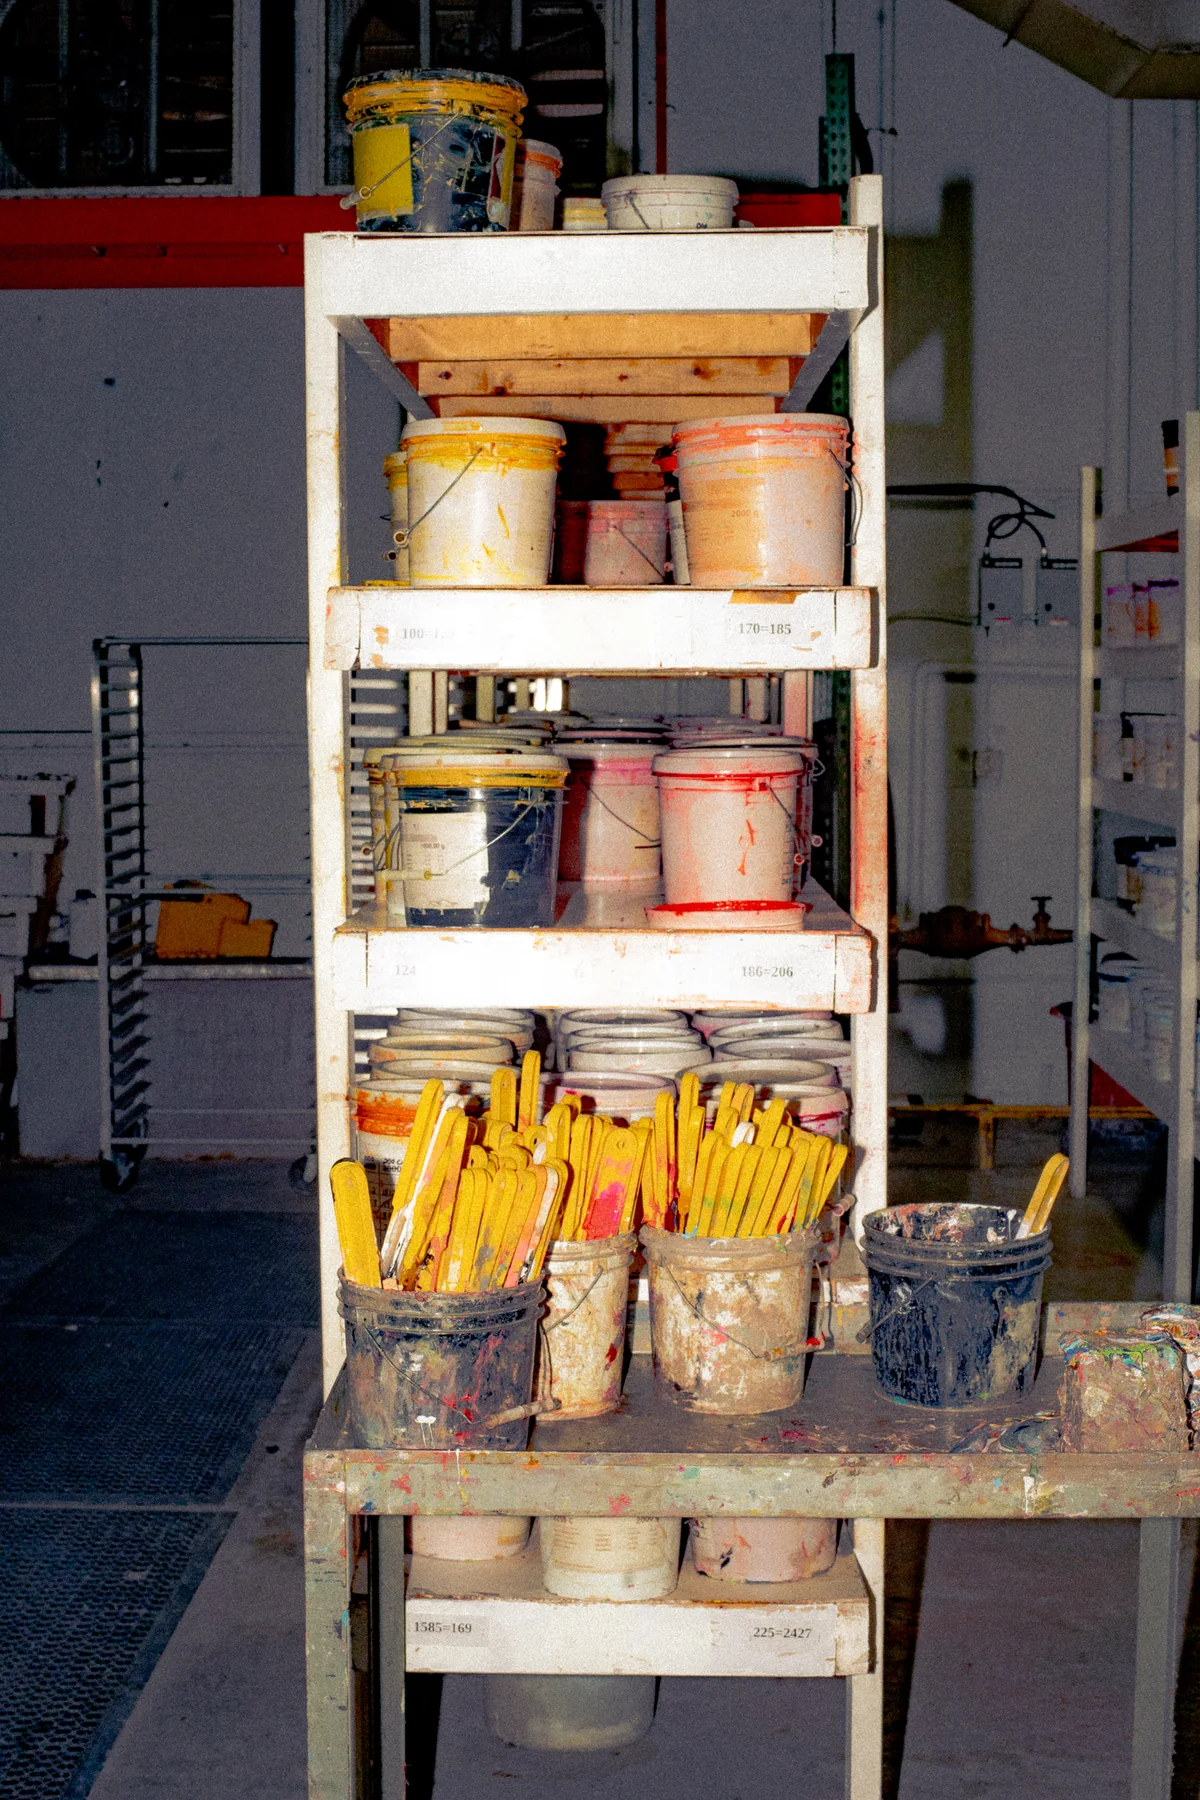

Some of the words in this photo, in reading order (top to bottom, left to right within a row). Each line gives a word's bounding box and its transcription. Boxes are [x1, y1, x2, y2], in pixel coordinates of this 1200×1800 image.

[731, 509, 751, 517] 2000
[739, 622, 792, 635] 170=185
[742, 965, 794, 978] 186=206
[414, 1620, 472, 1634] 1585=169
[753, 1626, 812, 1639] 225=2427
